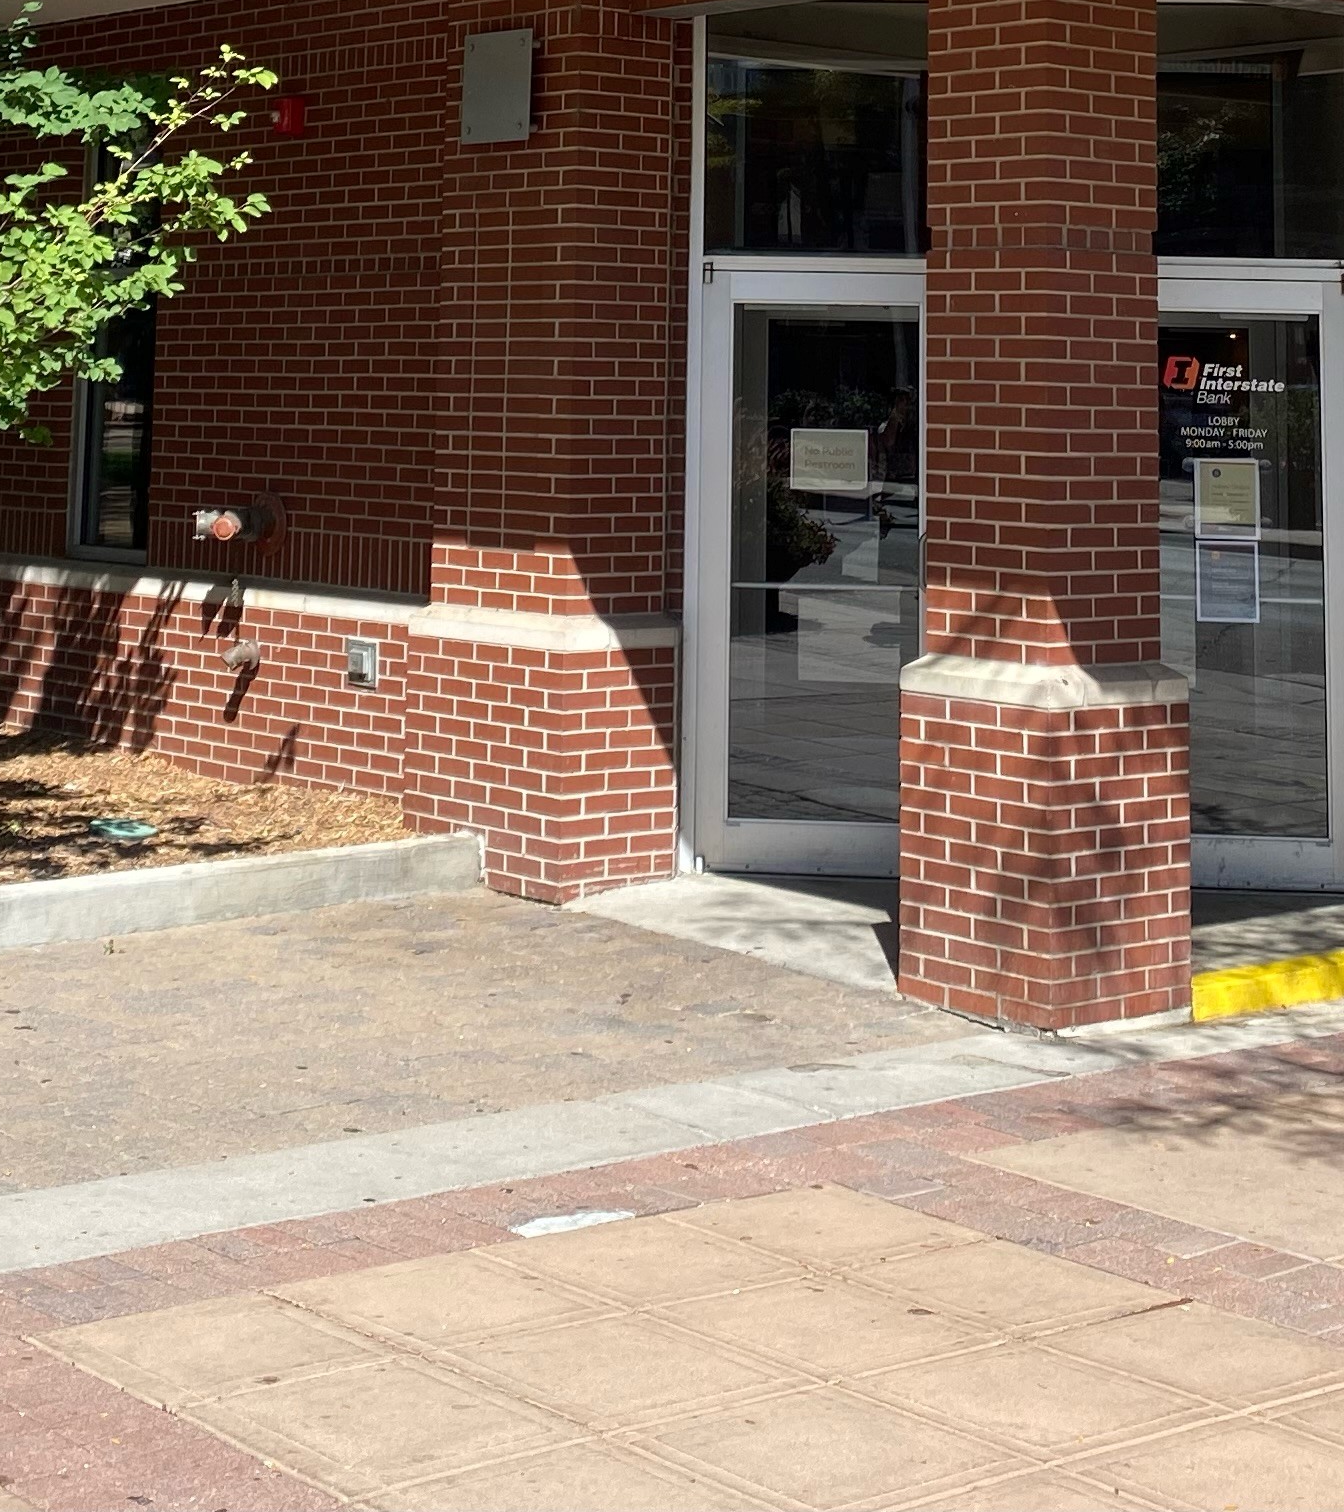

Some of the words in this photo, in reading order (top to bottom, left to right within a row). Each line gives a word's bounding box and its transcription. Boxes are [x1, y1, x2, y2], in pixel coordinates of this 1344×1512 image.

[1202, 363, 1243, 377] First
[1199, 377, 1285, 392] Interstate
[1196, 390, 1232, 405] Bank
[1208, 416, 1240, 426] LOBBY
[1180, 427, 1225, 437] MONDAY
[1232, 428, 1268, 438] FRIDAY
[1185, 439, 1221, 448] 9:00am
[1228, 440, 1264, 451] 5:00pm
[804, 446, 819, 456] No
[822, 446, 854, 457] Public
